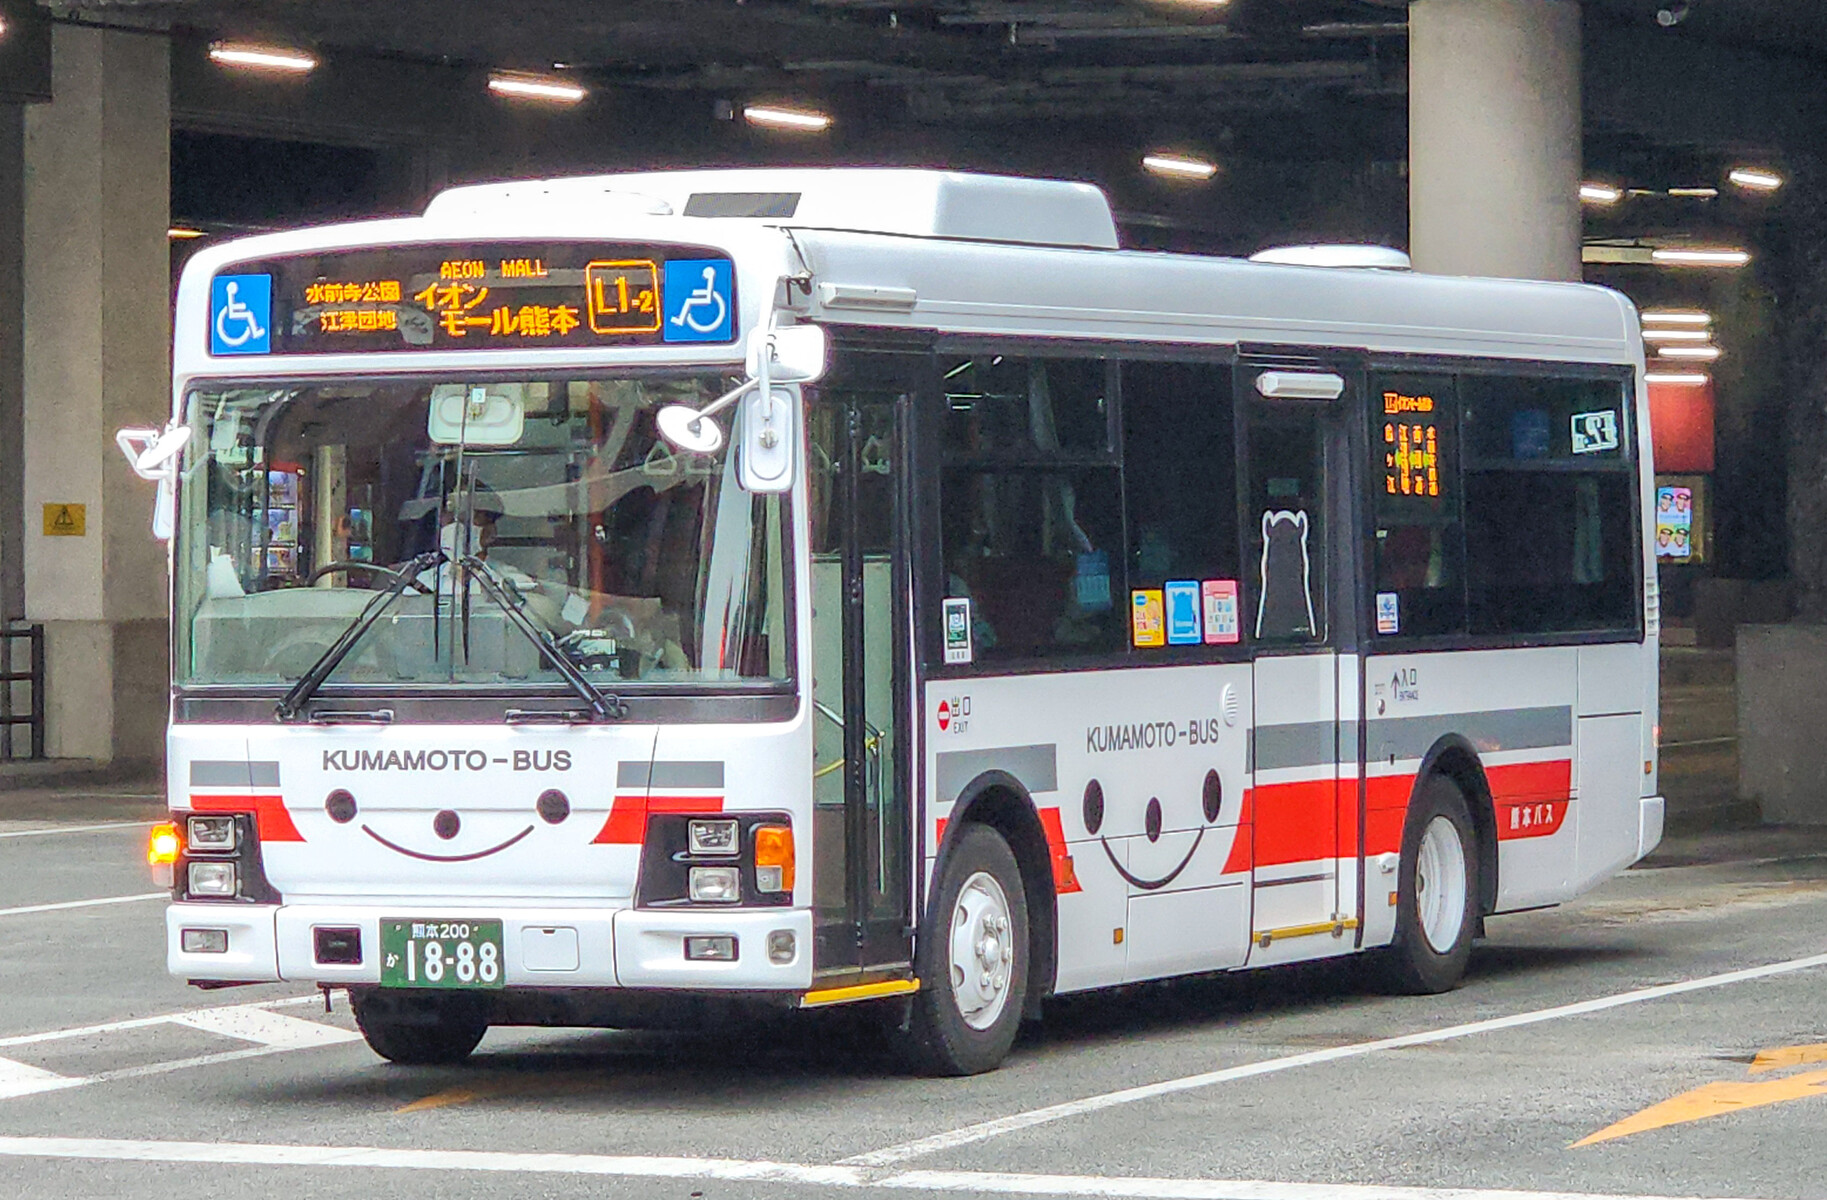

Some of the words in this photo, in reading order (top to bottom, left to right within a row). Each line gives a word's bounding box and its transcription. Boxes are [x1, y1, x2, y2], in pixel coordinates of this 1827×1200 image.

[440, 259, 485, 278] AEON
[501, 259, 547, 278] MALL
[305, 281, 401, 303] 水前寺公園
[414, 283, 489, 309] イオン
[320, 310, 398, 331] 江津団地
[440, 306, 580, 336] モール熊本
[951, 696, 970, 717] 出口
[953, 720, 968, 735] EXIT
[1510, 803, 1554, 830] 熊本バス
[386, 952, 399, 968] か
[406, 940, 499, 983] 18-88
